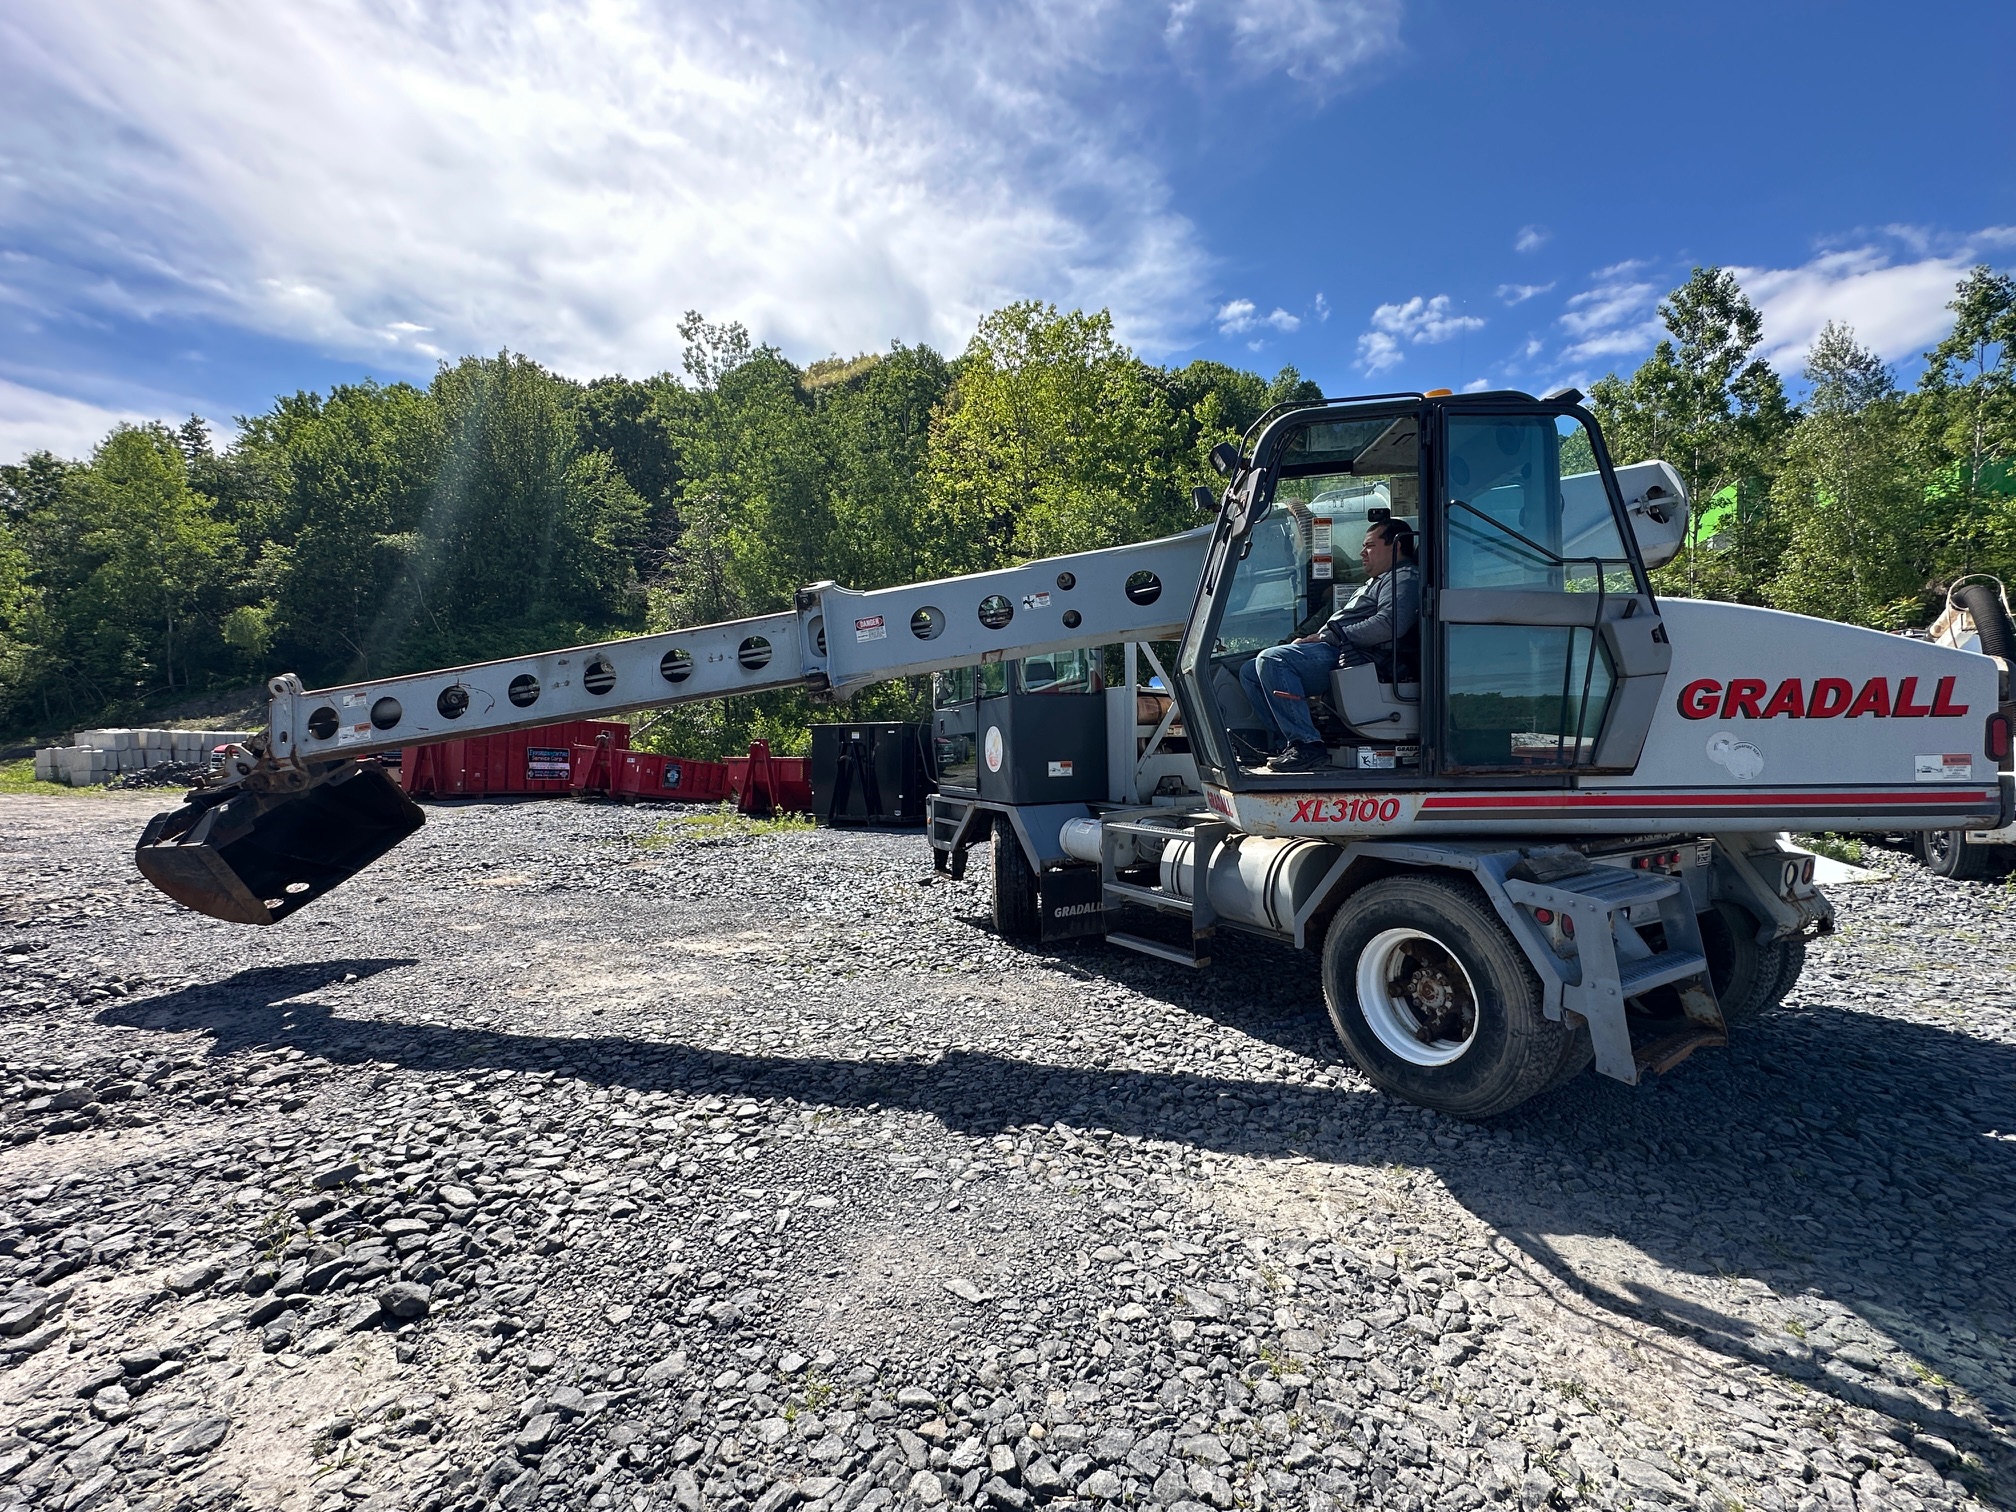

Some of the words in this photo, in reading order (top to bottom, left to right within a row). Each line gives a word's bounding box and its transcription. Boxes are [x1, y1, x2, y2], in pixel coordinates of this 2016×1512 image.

[1676, 676, 1969, 720] GRADALL
[1207, 790, 1234, 818] GRADALL
[1290, 798, 1400, 823] XL3100
[1054, 902, 1104, 918] GRADALL
